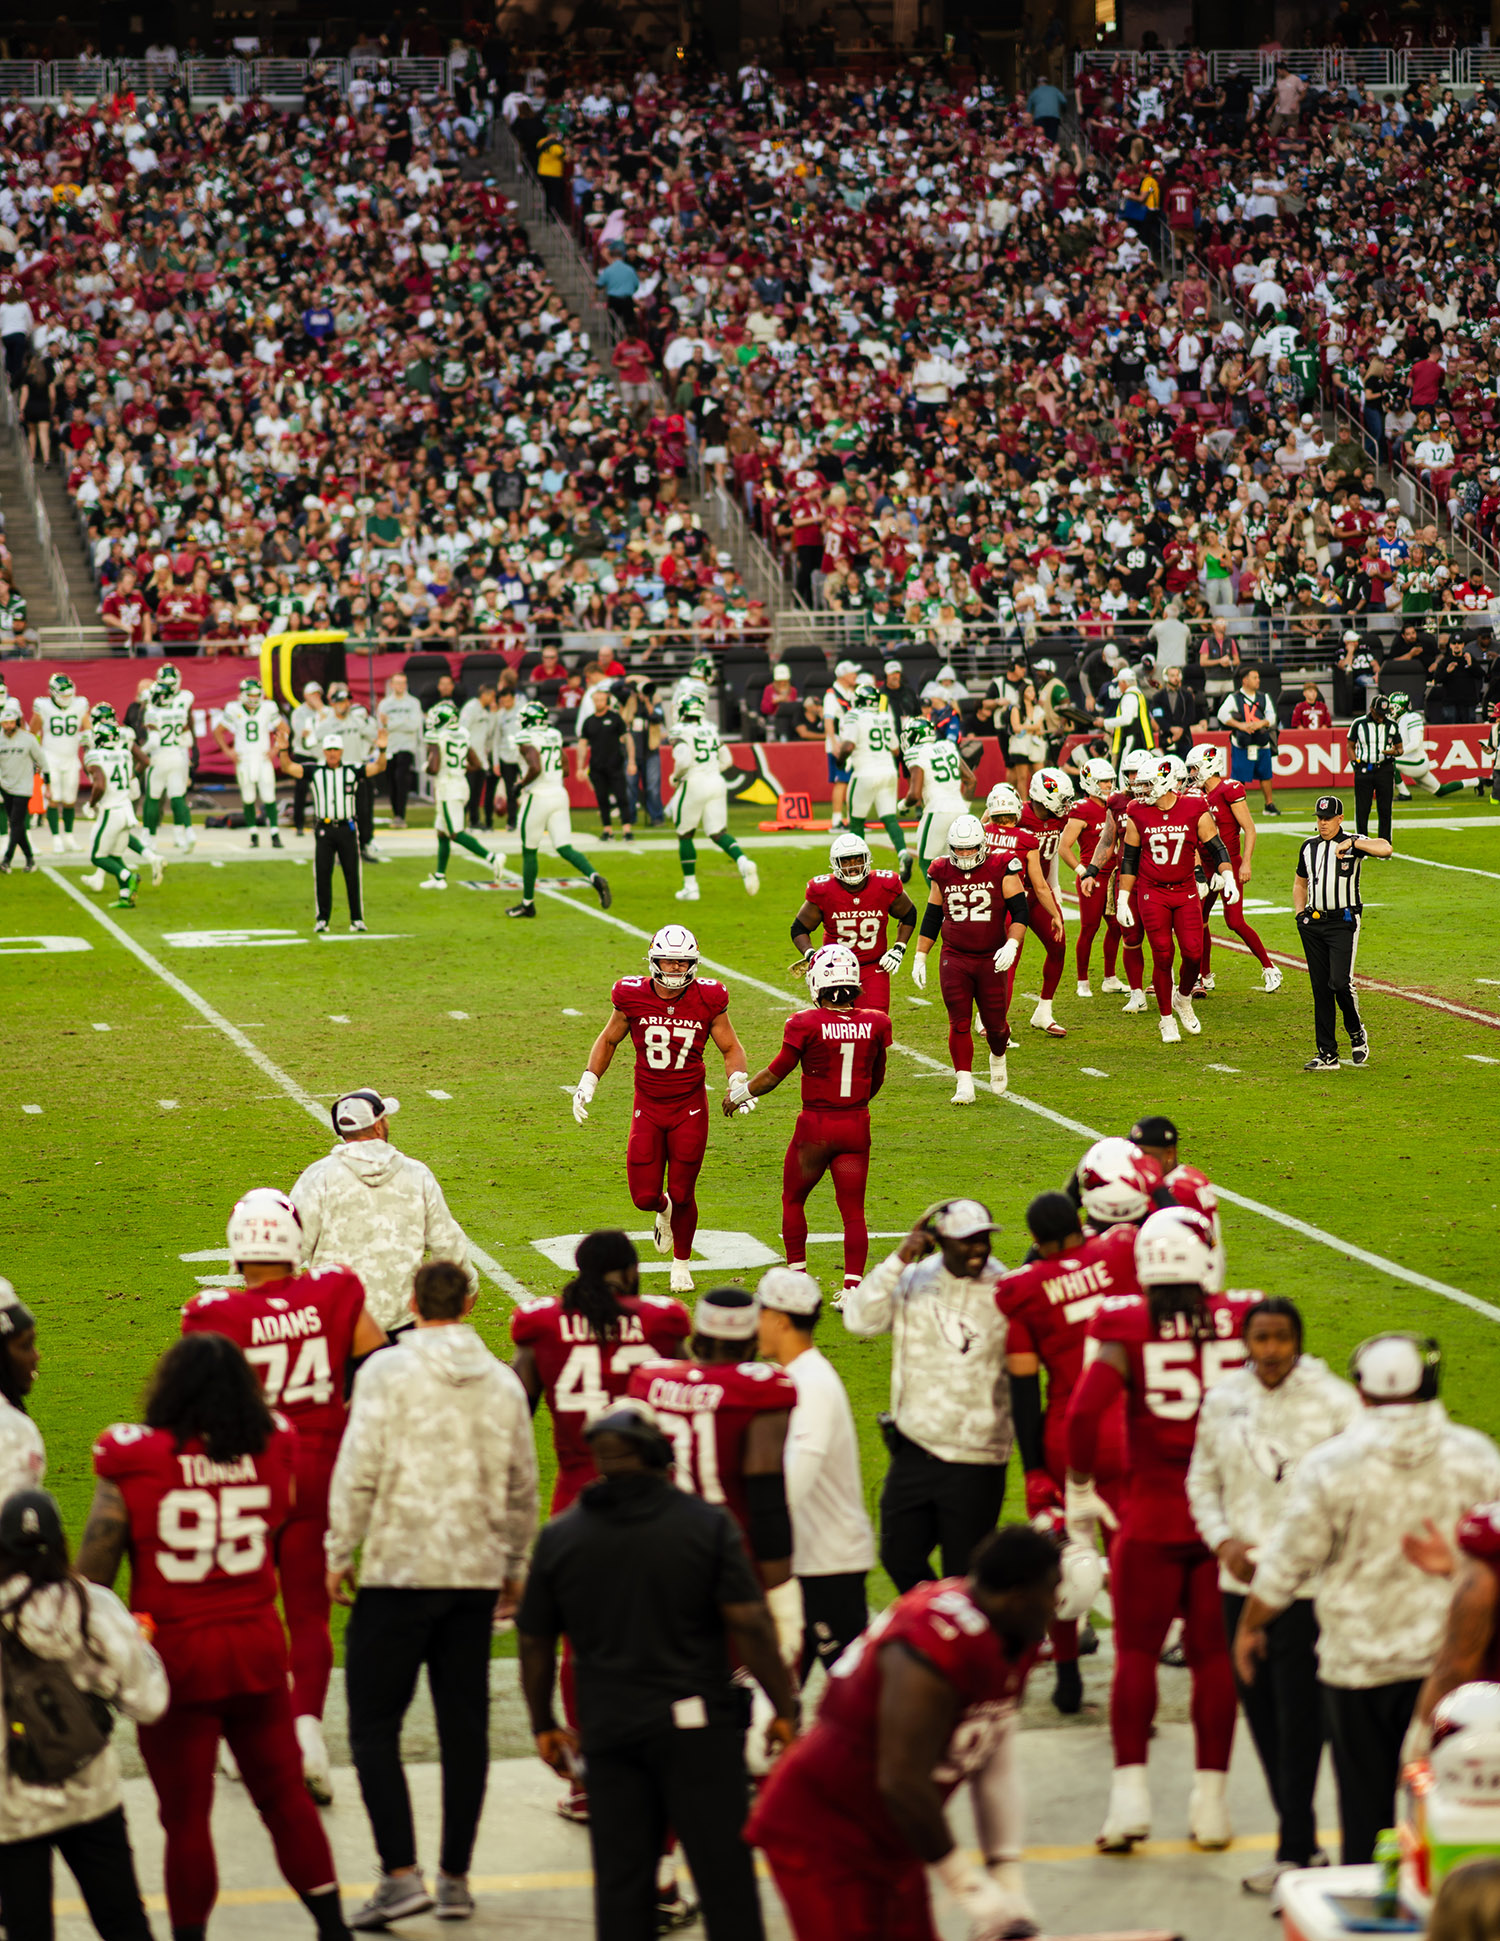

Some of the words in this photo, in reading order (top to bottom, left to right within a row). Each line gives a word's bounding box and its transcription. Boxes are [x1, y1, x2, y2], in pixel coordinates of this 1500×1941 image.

[634, 465, 650, 483] 15
[1127, 551, 1146, 568] 99
[50, 715, 78, 737] 66
[246, 721, 259, 742] 8
[541, 746, 562, 772] 72
[930, 754, 961, 782] 58
[110, 764, 130, 790] 41
[784, 797, 809, 818] 20
[1144, 825, 1189, 834] ARIZONA
[1149, 832, 1185, 865] 67
[944, 881, 994, 894] ARIZONA
[831, 910, 884, 919] ARIZONA
[947, 890, 992, 922] 62
[836, 918, 880, 951] 59
[639, 1016, 703, 1029] ARIZONA
[821, 1023, 872, 1040] MURRAY
[644, 1025, 696, 1070] 87
[840, 1043, 855, 1098] 1
[1041, 1259, 1115, 1306] WHITE
[251, 1305, 322, 1345] ADAMS
[245, 1336, 334, 1406] 74
[156, 1485, 271, 1583] 95
